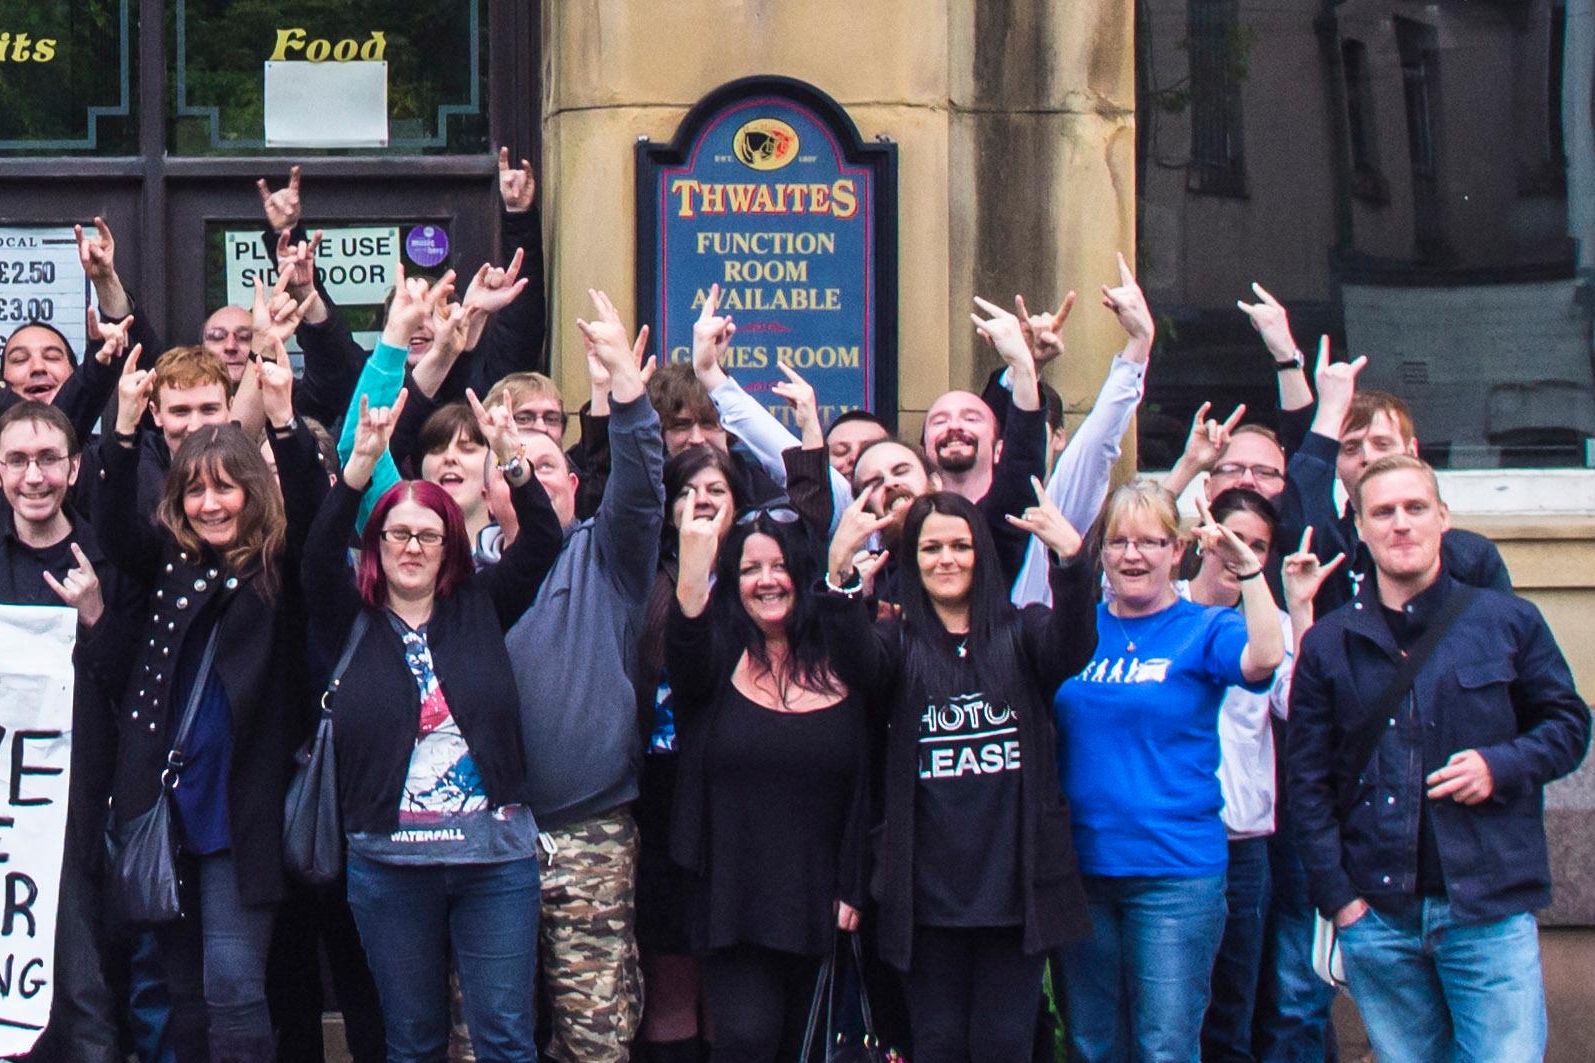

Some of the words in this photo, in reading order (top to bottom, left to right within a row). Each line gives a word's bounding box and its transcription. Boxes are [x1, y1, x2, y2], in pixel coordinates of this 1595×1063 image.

[269, 28, 386, 62] Food
[672, 179, 857, 218] THWAITES
[235, 239, 333, 260] PLE
[342, 237, 391, 256] USE
[696, 232, 835, 255] FUNCTION
[241, 268, 280, 287] SID
[724, 261, 808, 282] ROOM
[690, 288, 842, 310] AVAILABLE
[671, 346, 768, 368] GMES
[777, 346, 860, 368] ROOM
[919, 741, 1021, 779] LEASE
